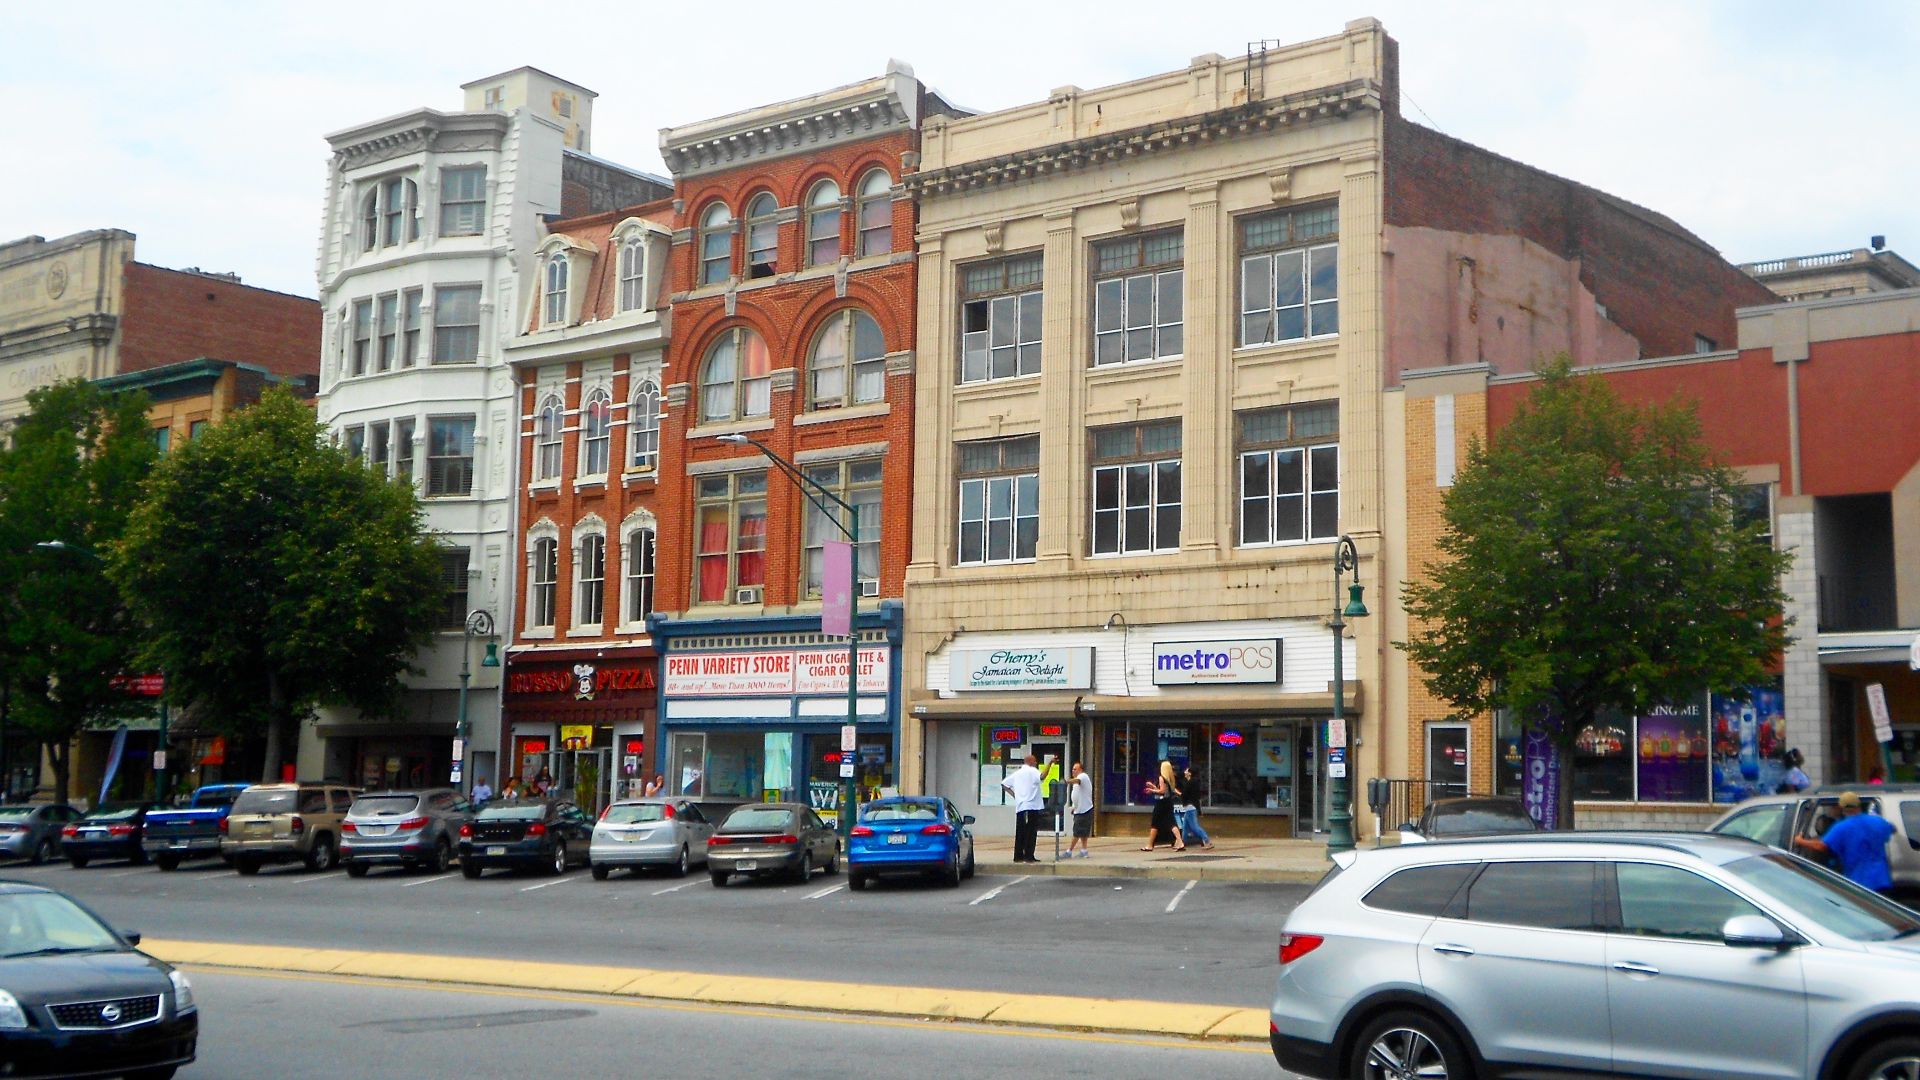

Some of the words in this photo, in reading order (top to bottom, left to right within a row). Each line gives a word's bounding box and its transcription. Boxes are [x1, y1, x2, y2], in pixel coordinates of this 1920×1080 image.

[668, 658, 699, 676] PENN
[703, 656, 750, 676] VARIETY
[753, 655, 790, 674] STORE
[799, 654, 823, 665] PENN
[825, 652, 874, 664] CIGATTE
[877, 652, 885, 663] &
[990, 649, 1047, 667] Cherry's
[1157, 646, 1273, 671] metroPCS
[809, 666, 836, 677] CIGAR
[839, 664, 873, 677] OLET
[972, 665, 1022, 681] Jamaican
[1025, 664, 1064, 679] Delight
[510, 671, 573, 694] RUSSO
[596, 668, 655, 691] PIZZA
[1681, 705, 1700, 716] ME
[995, 731, 1018, 741] OPEN
[1157, 728, 1189, 738] FREE
